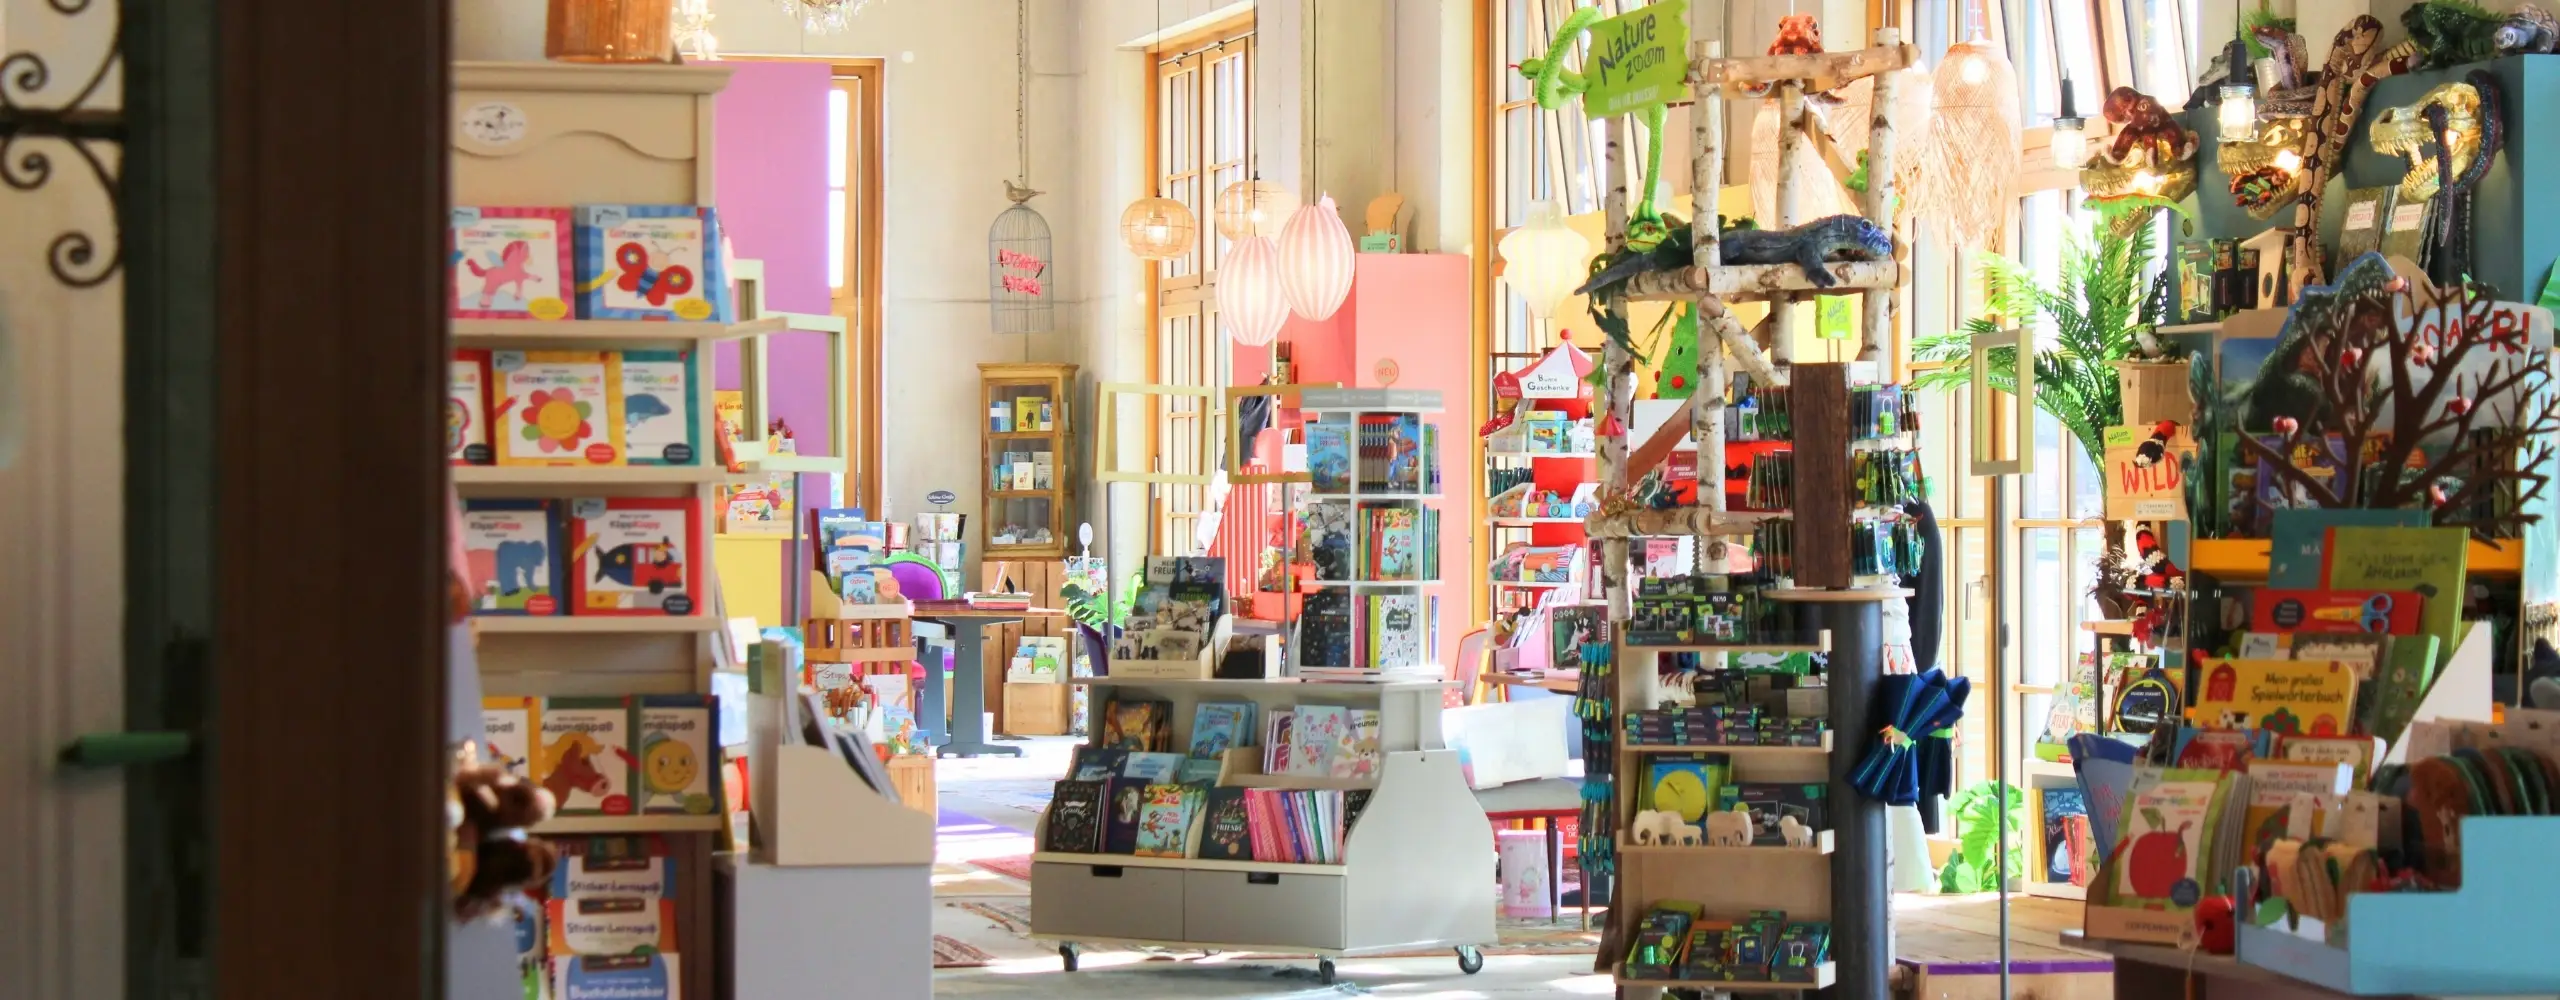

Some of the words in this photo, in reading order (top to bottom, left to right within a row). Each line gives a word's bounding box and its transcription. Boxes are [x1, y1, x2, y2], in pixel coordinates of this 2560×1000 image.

[1598, 13, 1656, 87] Nature
[1625, 45, 1665, 83] zoom
[1377, 367, 1396, 376] NEU
[1538, 374, 1558, 382] Bunte
[1527, 381, 1571, 391] Geschenke
[2107, 431, 2129, 443] Nature
[2120, 451, 2180, 495] WILD
[1154, 567, 1176, 575] FREUN
[2265, 673, 2289, 684] Mein
[2290, 673, 2324, 691] großes
[2251, 685, 2344, 704] Spielwörterbuch
[541, 720, 614, 734] Ausmalspaß
[1215, 823, 1242, 832] FRIENDS
